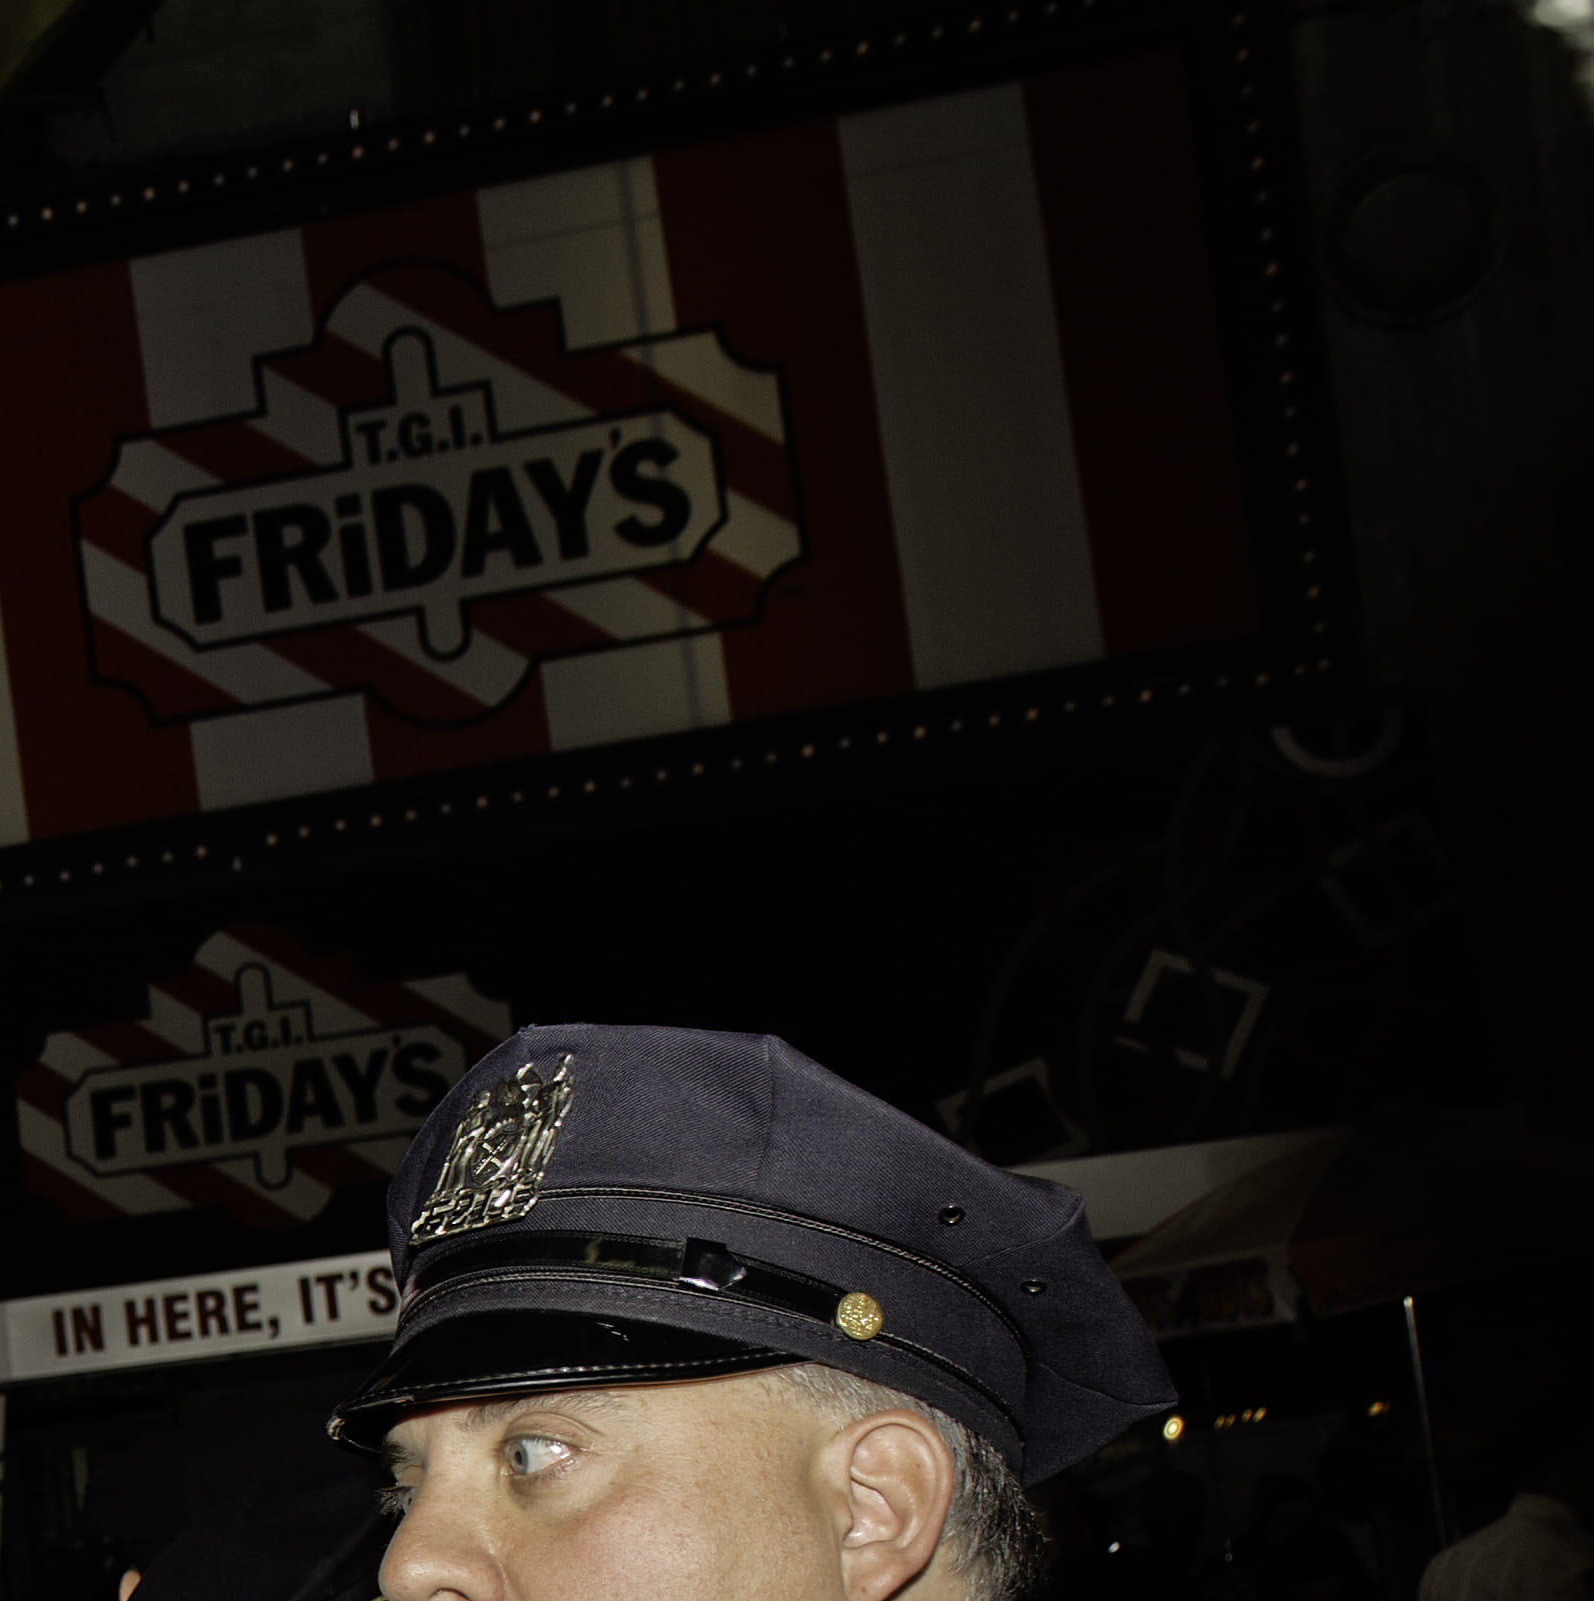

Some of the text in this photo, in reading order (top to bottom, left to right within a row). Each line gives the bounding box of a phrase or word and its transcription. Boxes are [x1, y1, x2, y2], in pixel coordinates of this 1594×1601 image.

[355, 405, 483, 465] T.G.I.
[216, 1016, 303, 1055] T.G.I.
[53, 1266, 397, 1357] IN HERE, IT'S
